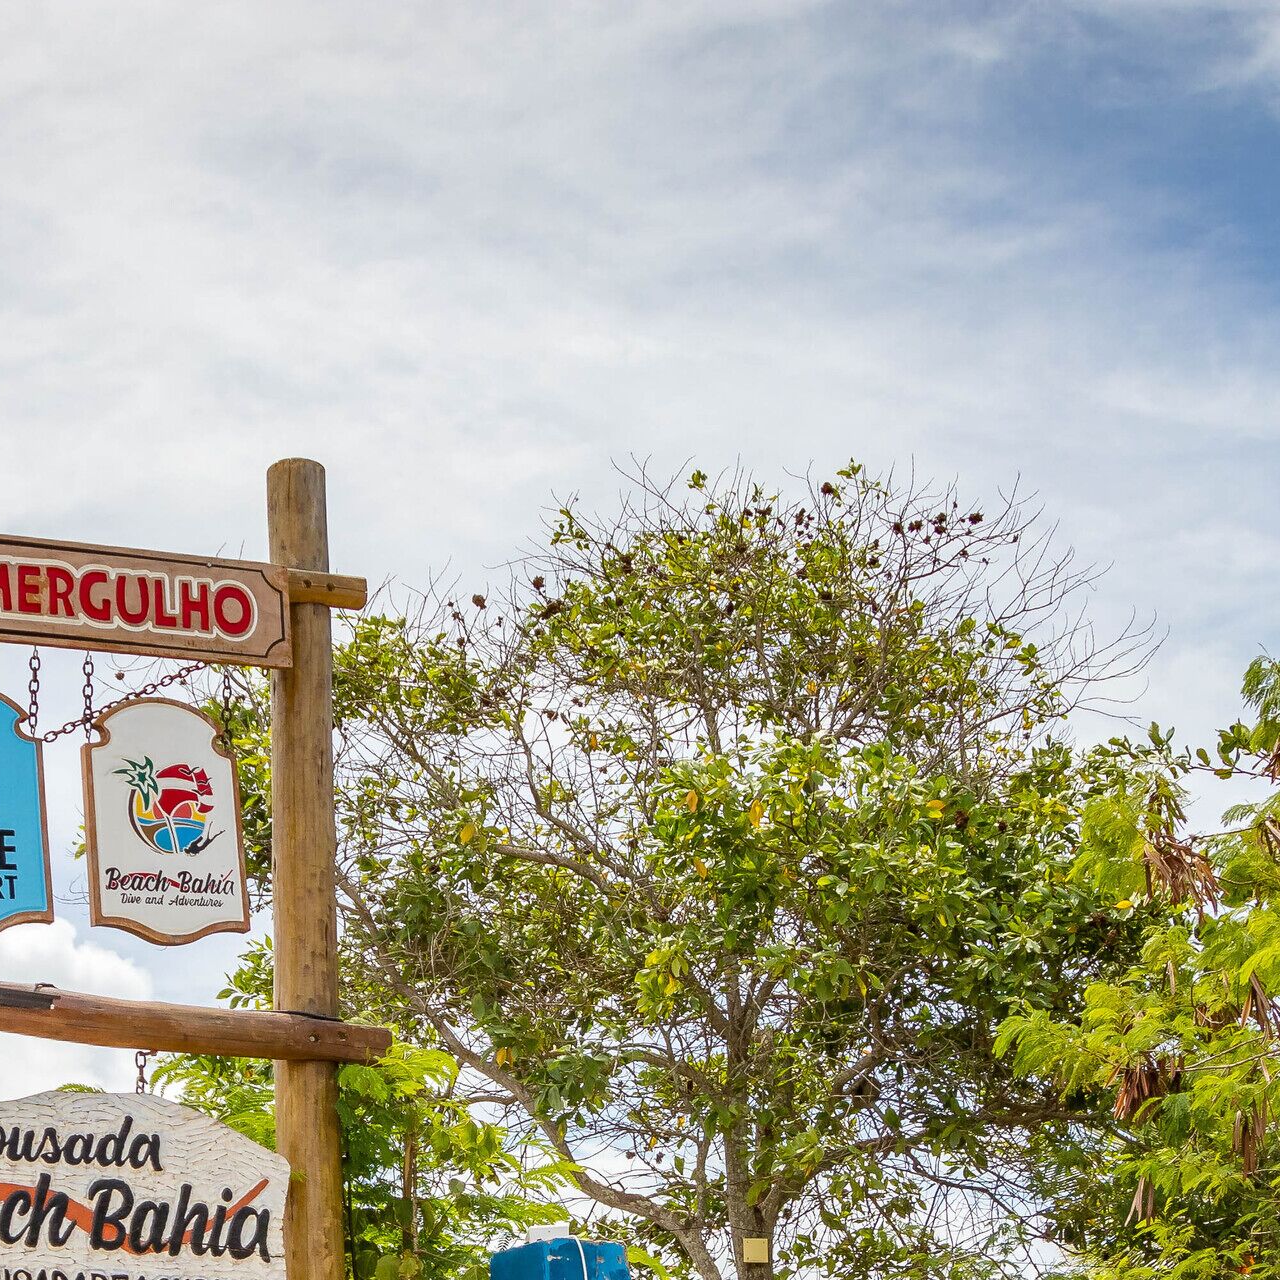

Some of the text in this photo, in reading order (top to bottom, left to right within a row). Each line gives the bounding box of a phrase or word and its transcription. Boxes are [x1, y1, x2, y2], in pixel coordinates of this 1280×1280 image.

[105, 866, 170, 892] Beach
[120, 892, 224, 908] Dive and Adventures
